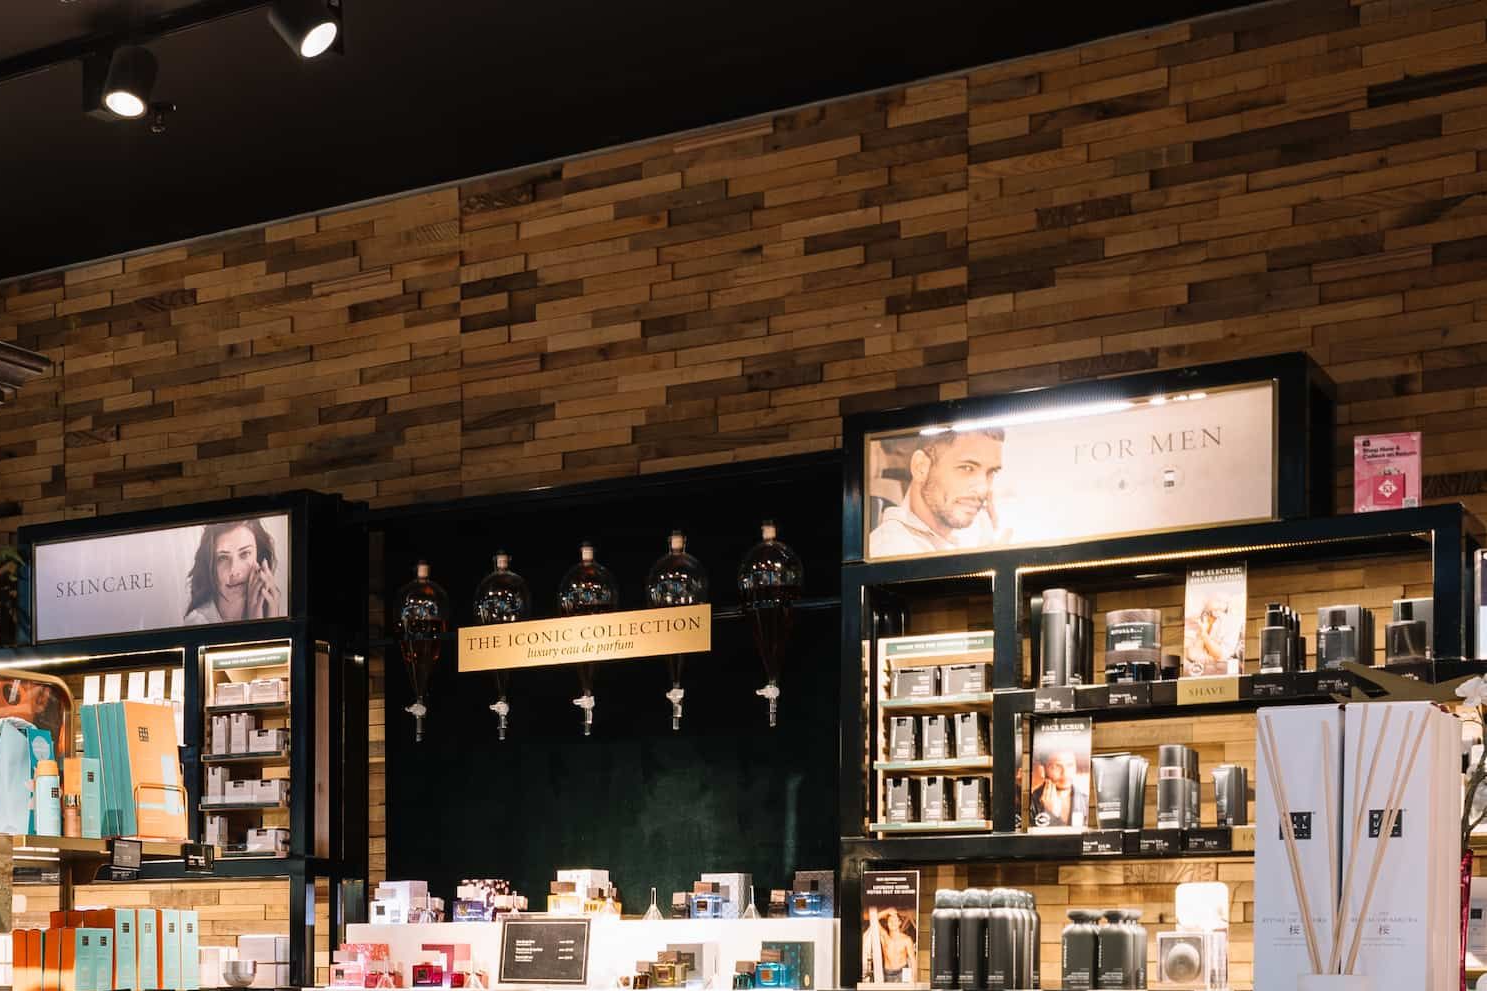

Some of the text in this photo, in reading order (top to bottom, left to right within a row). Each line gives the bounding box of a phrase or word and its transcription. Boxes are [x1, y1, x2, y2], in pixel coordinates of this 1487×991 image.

[1150, 426, 1222, 454] MEN
[56, 572, 153, 598] SKINCARE
[466, 616, 702, 650] THE ICONIC COLLECTION
[527, 639, 634, 659] luxury eau de parfum
[1188, 686, 1225, 697] SHAVE
